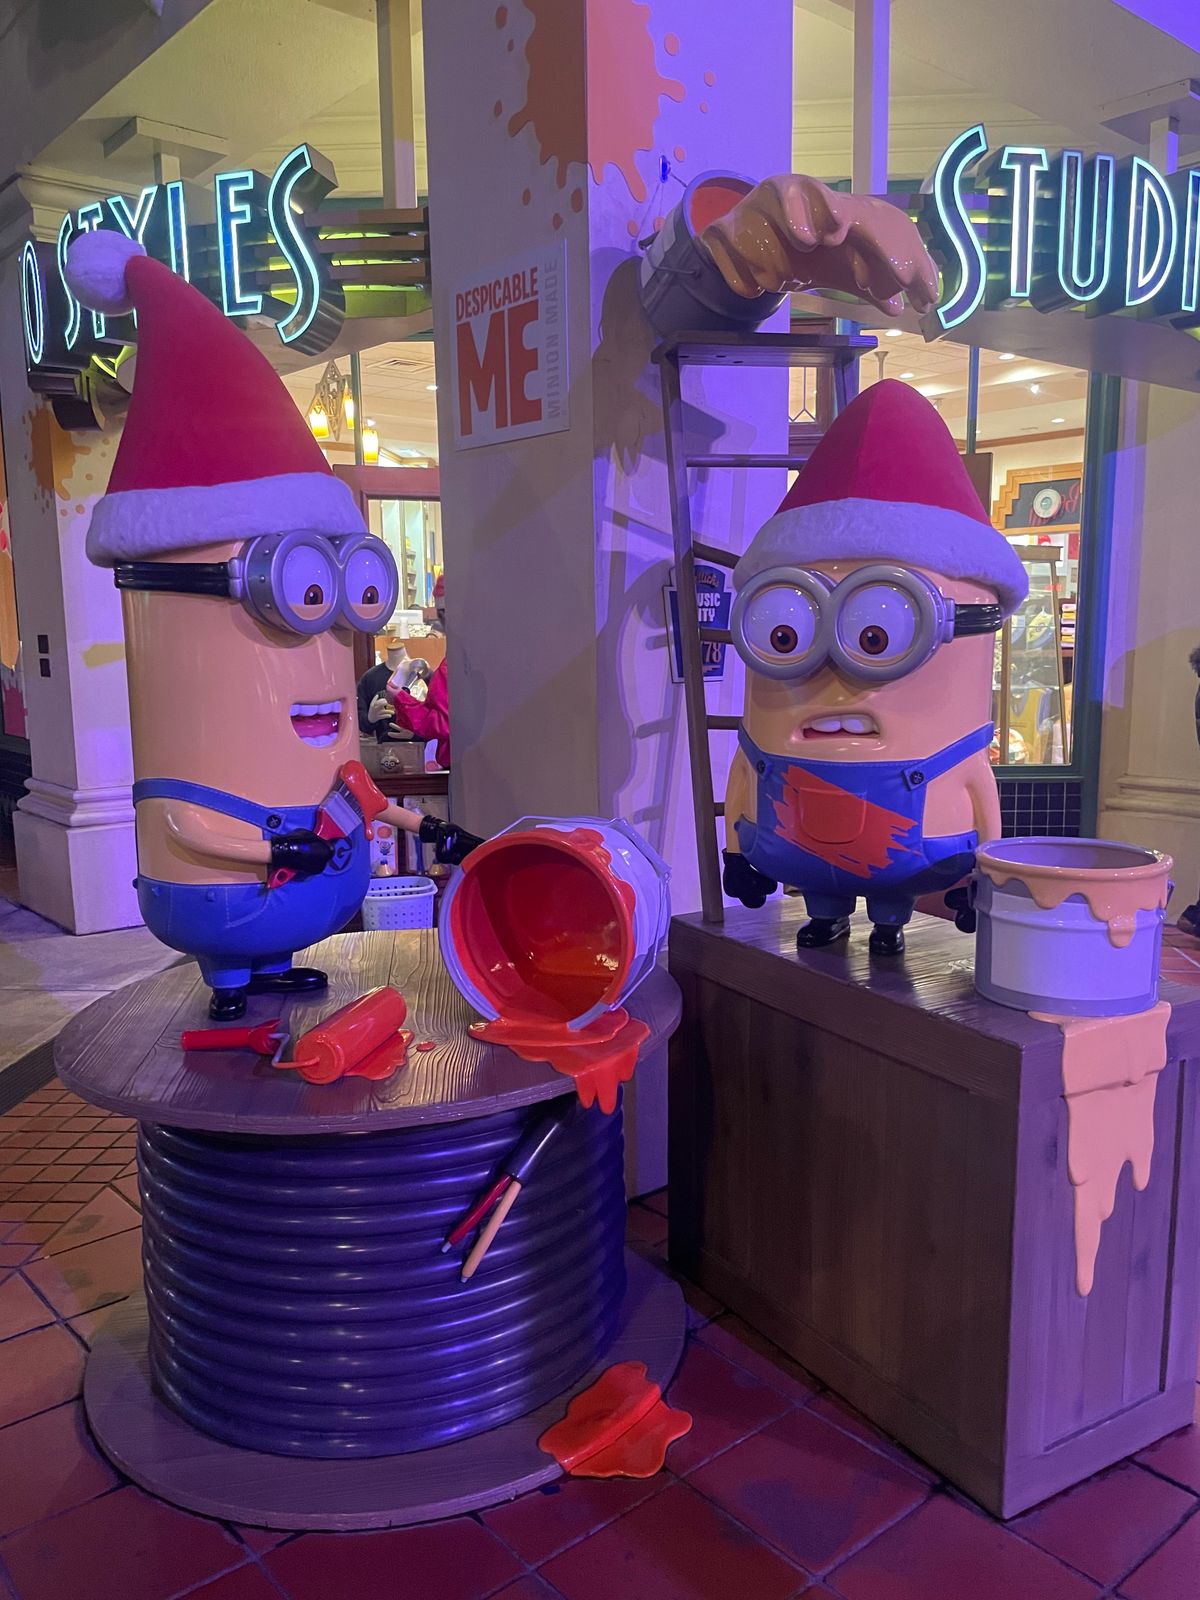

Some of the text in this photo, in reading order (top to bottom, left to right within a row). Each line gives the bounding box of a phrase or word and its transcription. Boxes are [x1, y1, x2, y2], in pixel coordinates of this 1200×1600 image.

[456, 266, 539, 321] DESPICABLE
[544, 257, 561, 419] MINION MADE
[456, 299, 542, 437] ME
[697, 592, 720, 607] USIC
[698, 607, 716, 622] ITY
[703, 641, 721, 663] 78
